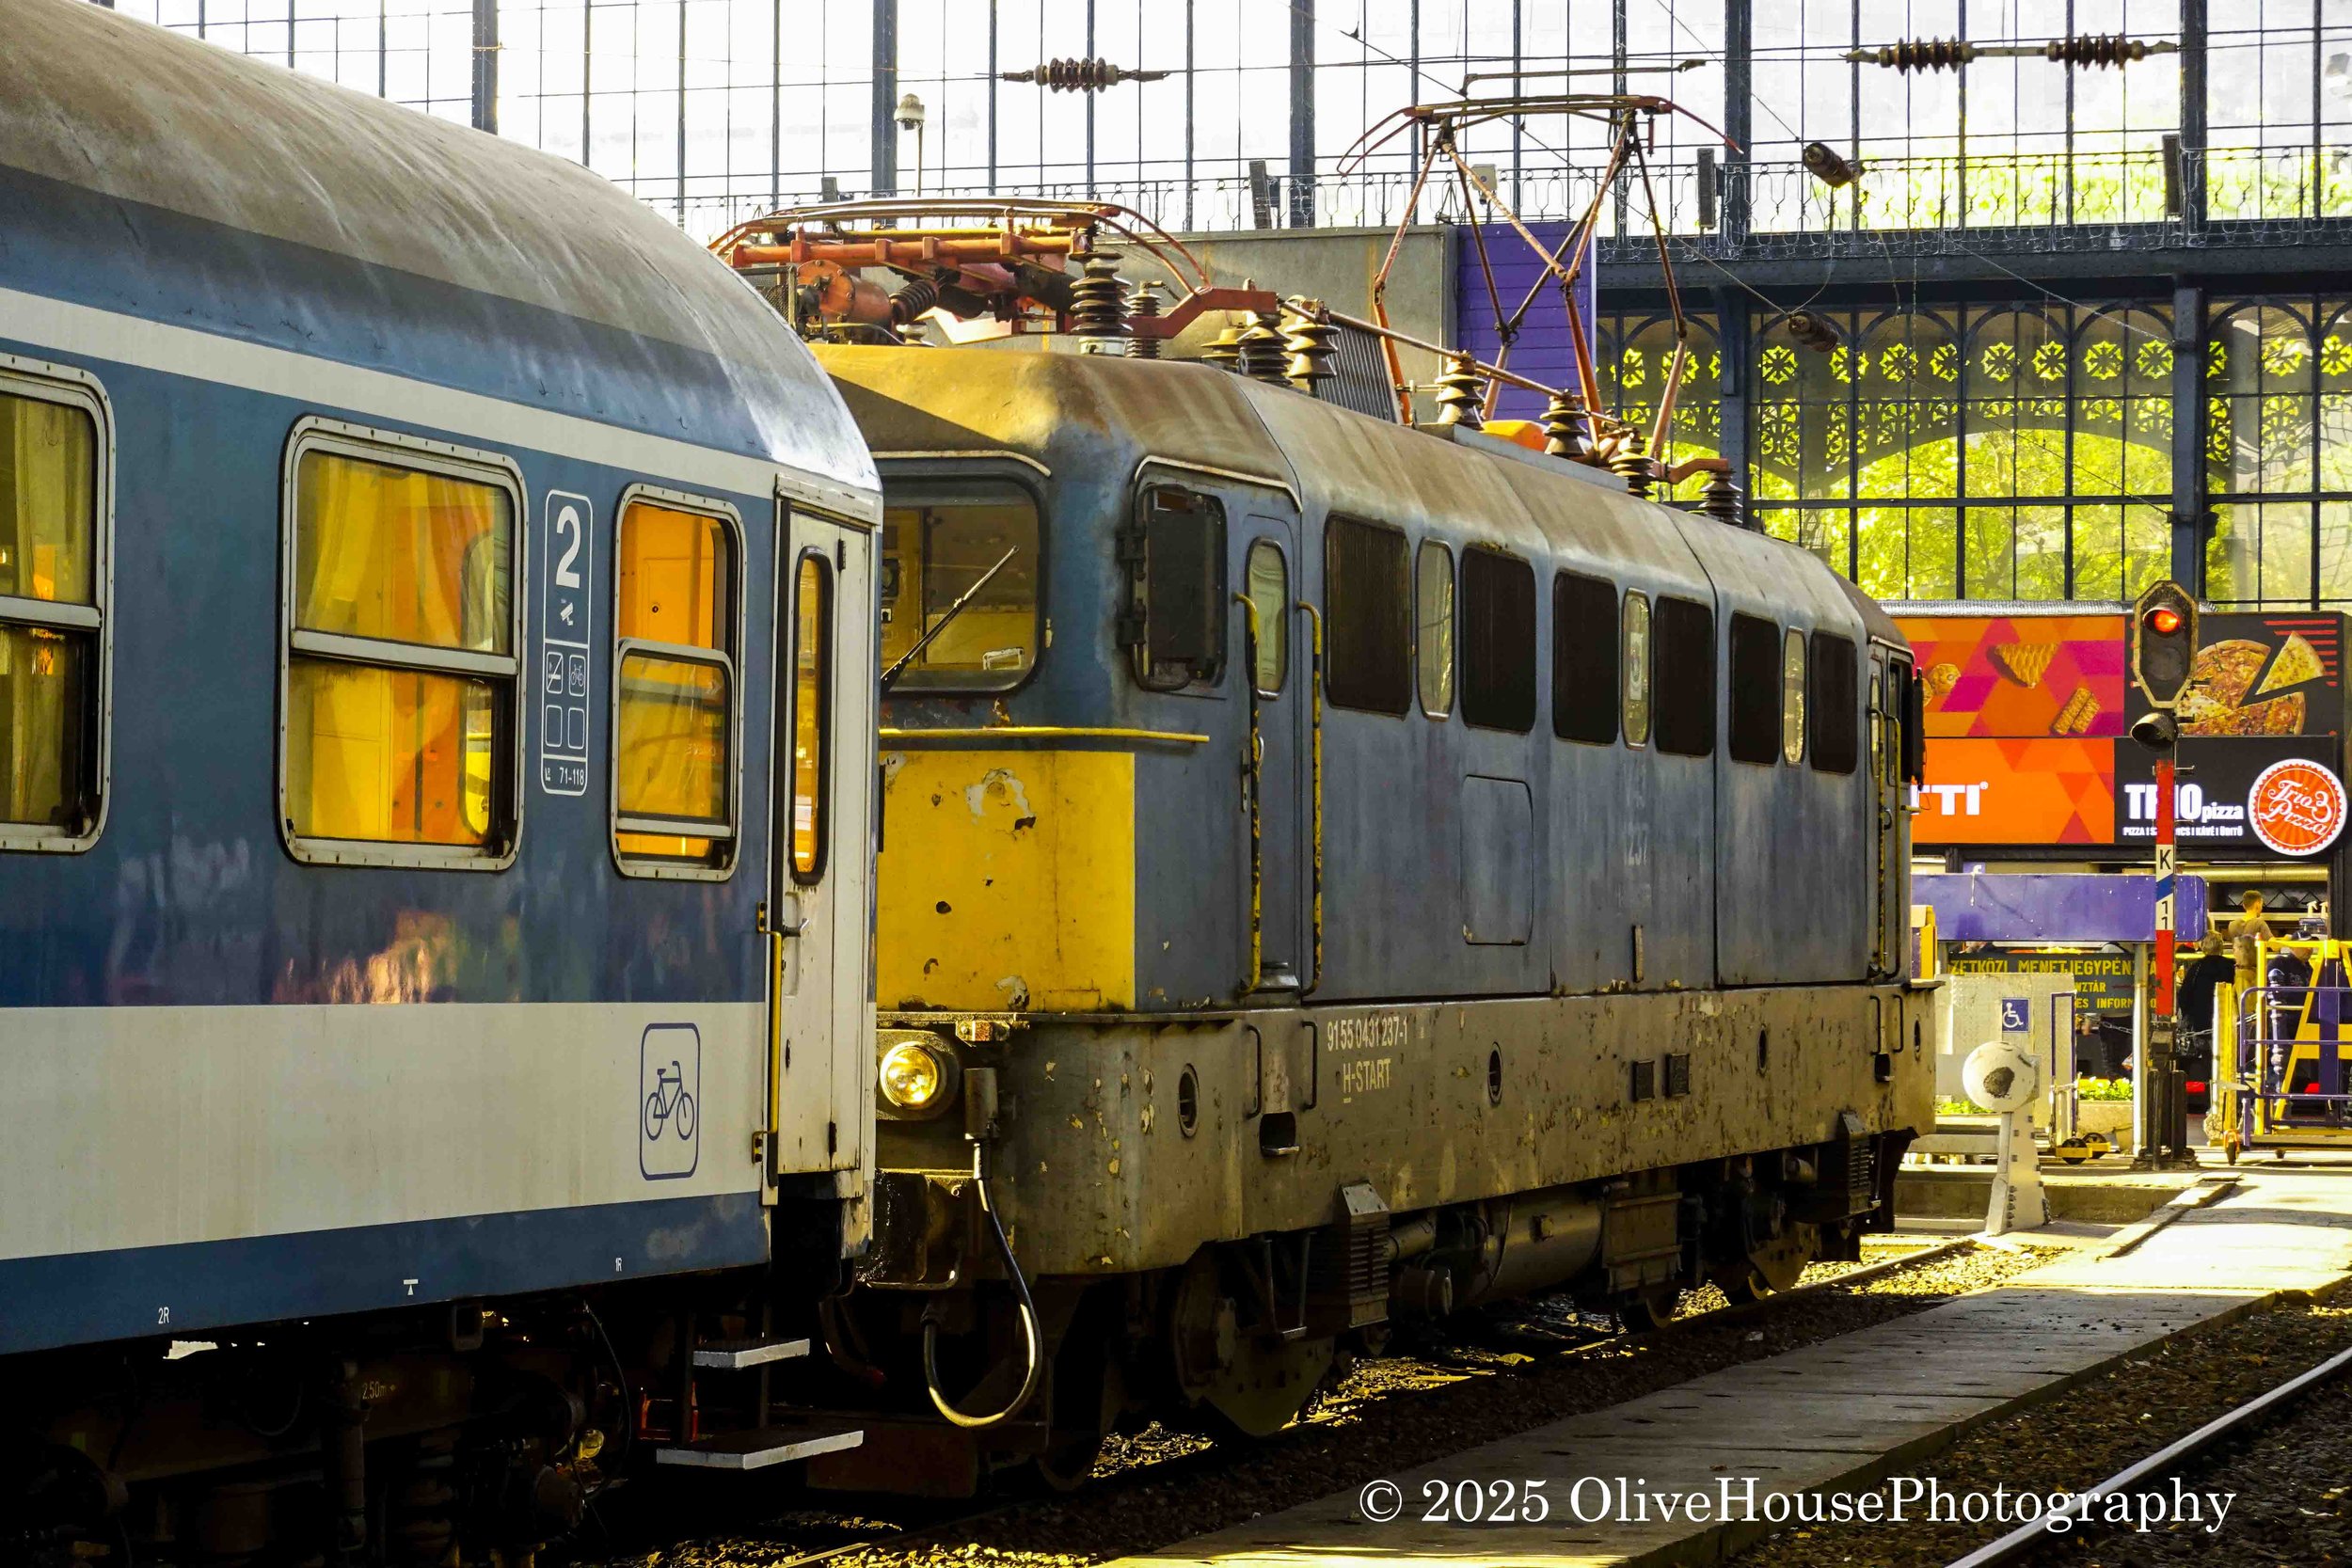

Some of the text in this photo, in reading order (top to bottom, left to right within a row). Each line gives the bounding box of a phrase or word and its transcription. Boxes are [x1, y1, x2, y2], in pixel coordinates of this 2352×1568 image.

[555, 505, 581, 589] 2
[559, 767, 584, 786] 71-118
[2258, 799, 2328, 836] Pizza
[2159, 848, 2171, 870] K
[1343, 1057, 1392, 1094] H-START
[158, 1307, 170, 1324] 2R
